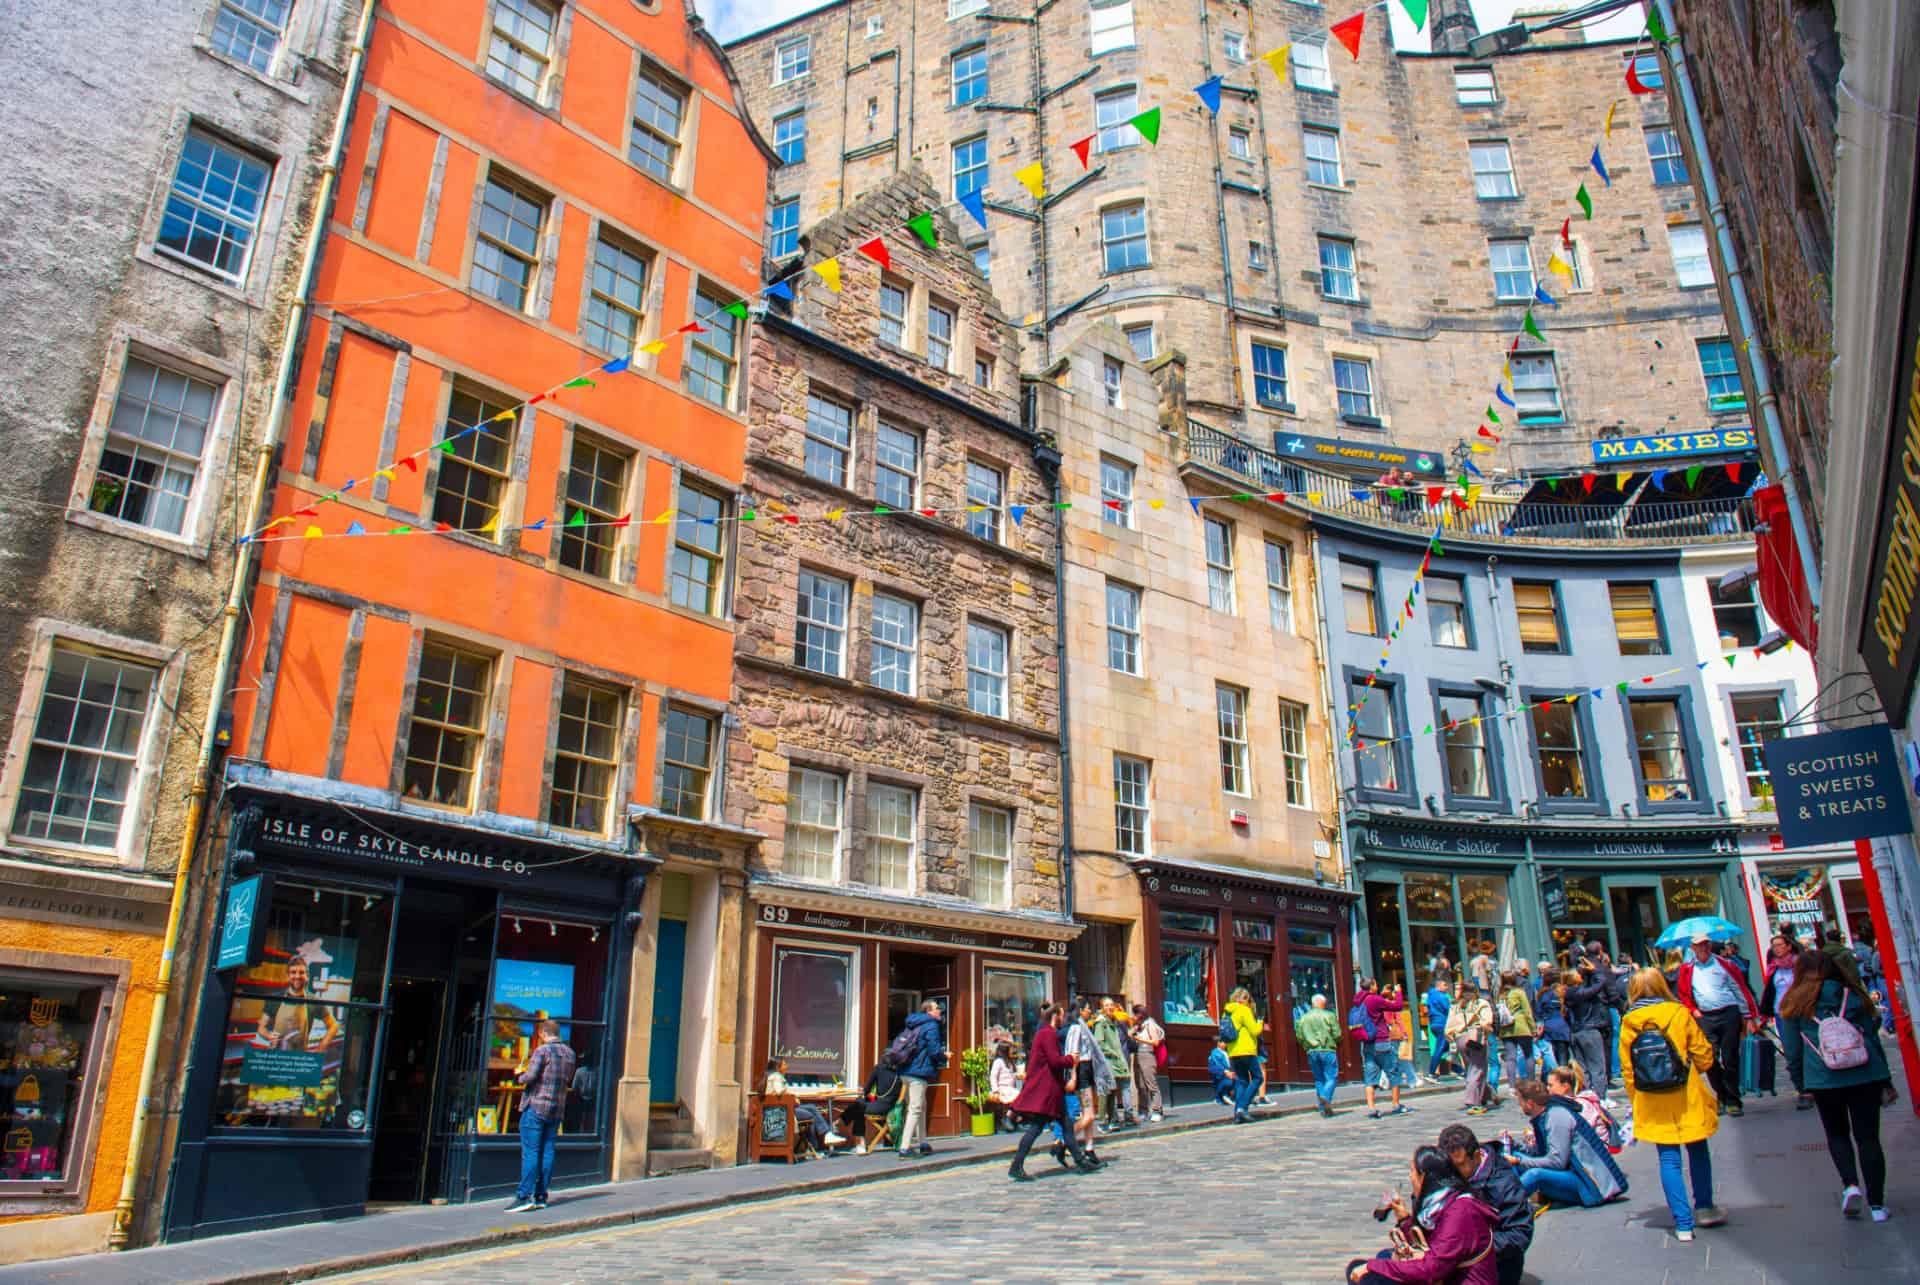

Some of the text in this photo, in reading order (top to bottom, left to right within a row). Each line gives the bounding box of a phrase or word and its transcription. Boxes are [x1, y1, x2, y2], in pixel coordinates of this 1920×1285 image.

[1600, 431, 1749, 458] MAXIES
[1787, 751, 1880, 776] SCOTTISH
[1800, 775, 1875, 797] SWEETS
[1799, 796, 1888, 820] & TREATS
[263, 818, 532, 875] ISLE OF SKYE CANDLE CO.
[1400, 833, 1448, 851] Walker
[1456, 839, 1501, 853] Slater
[1594, 842, 1665, 855] LADIESWEAR
[1711, 838, 1740, 854] 44.
[763, 906, 789, 922] 89
[1048, 941, 1067, 955] 89
